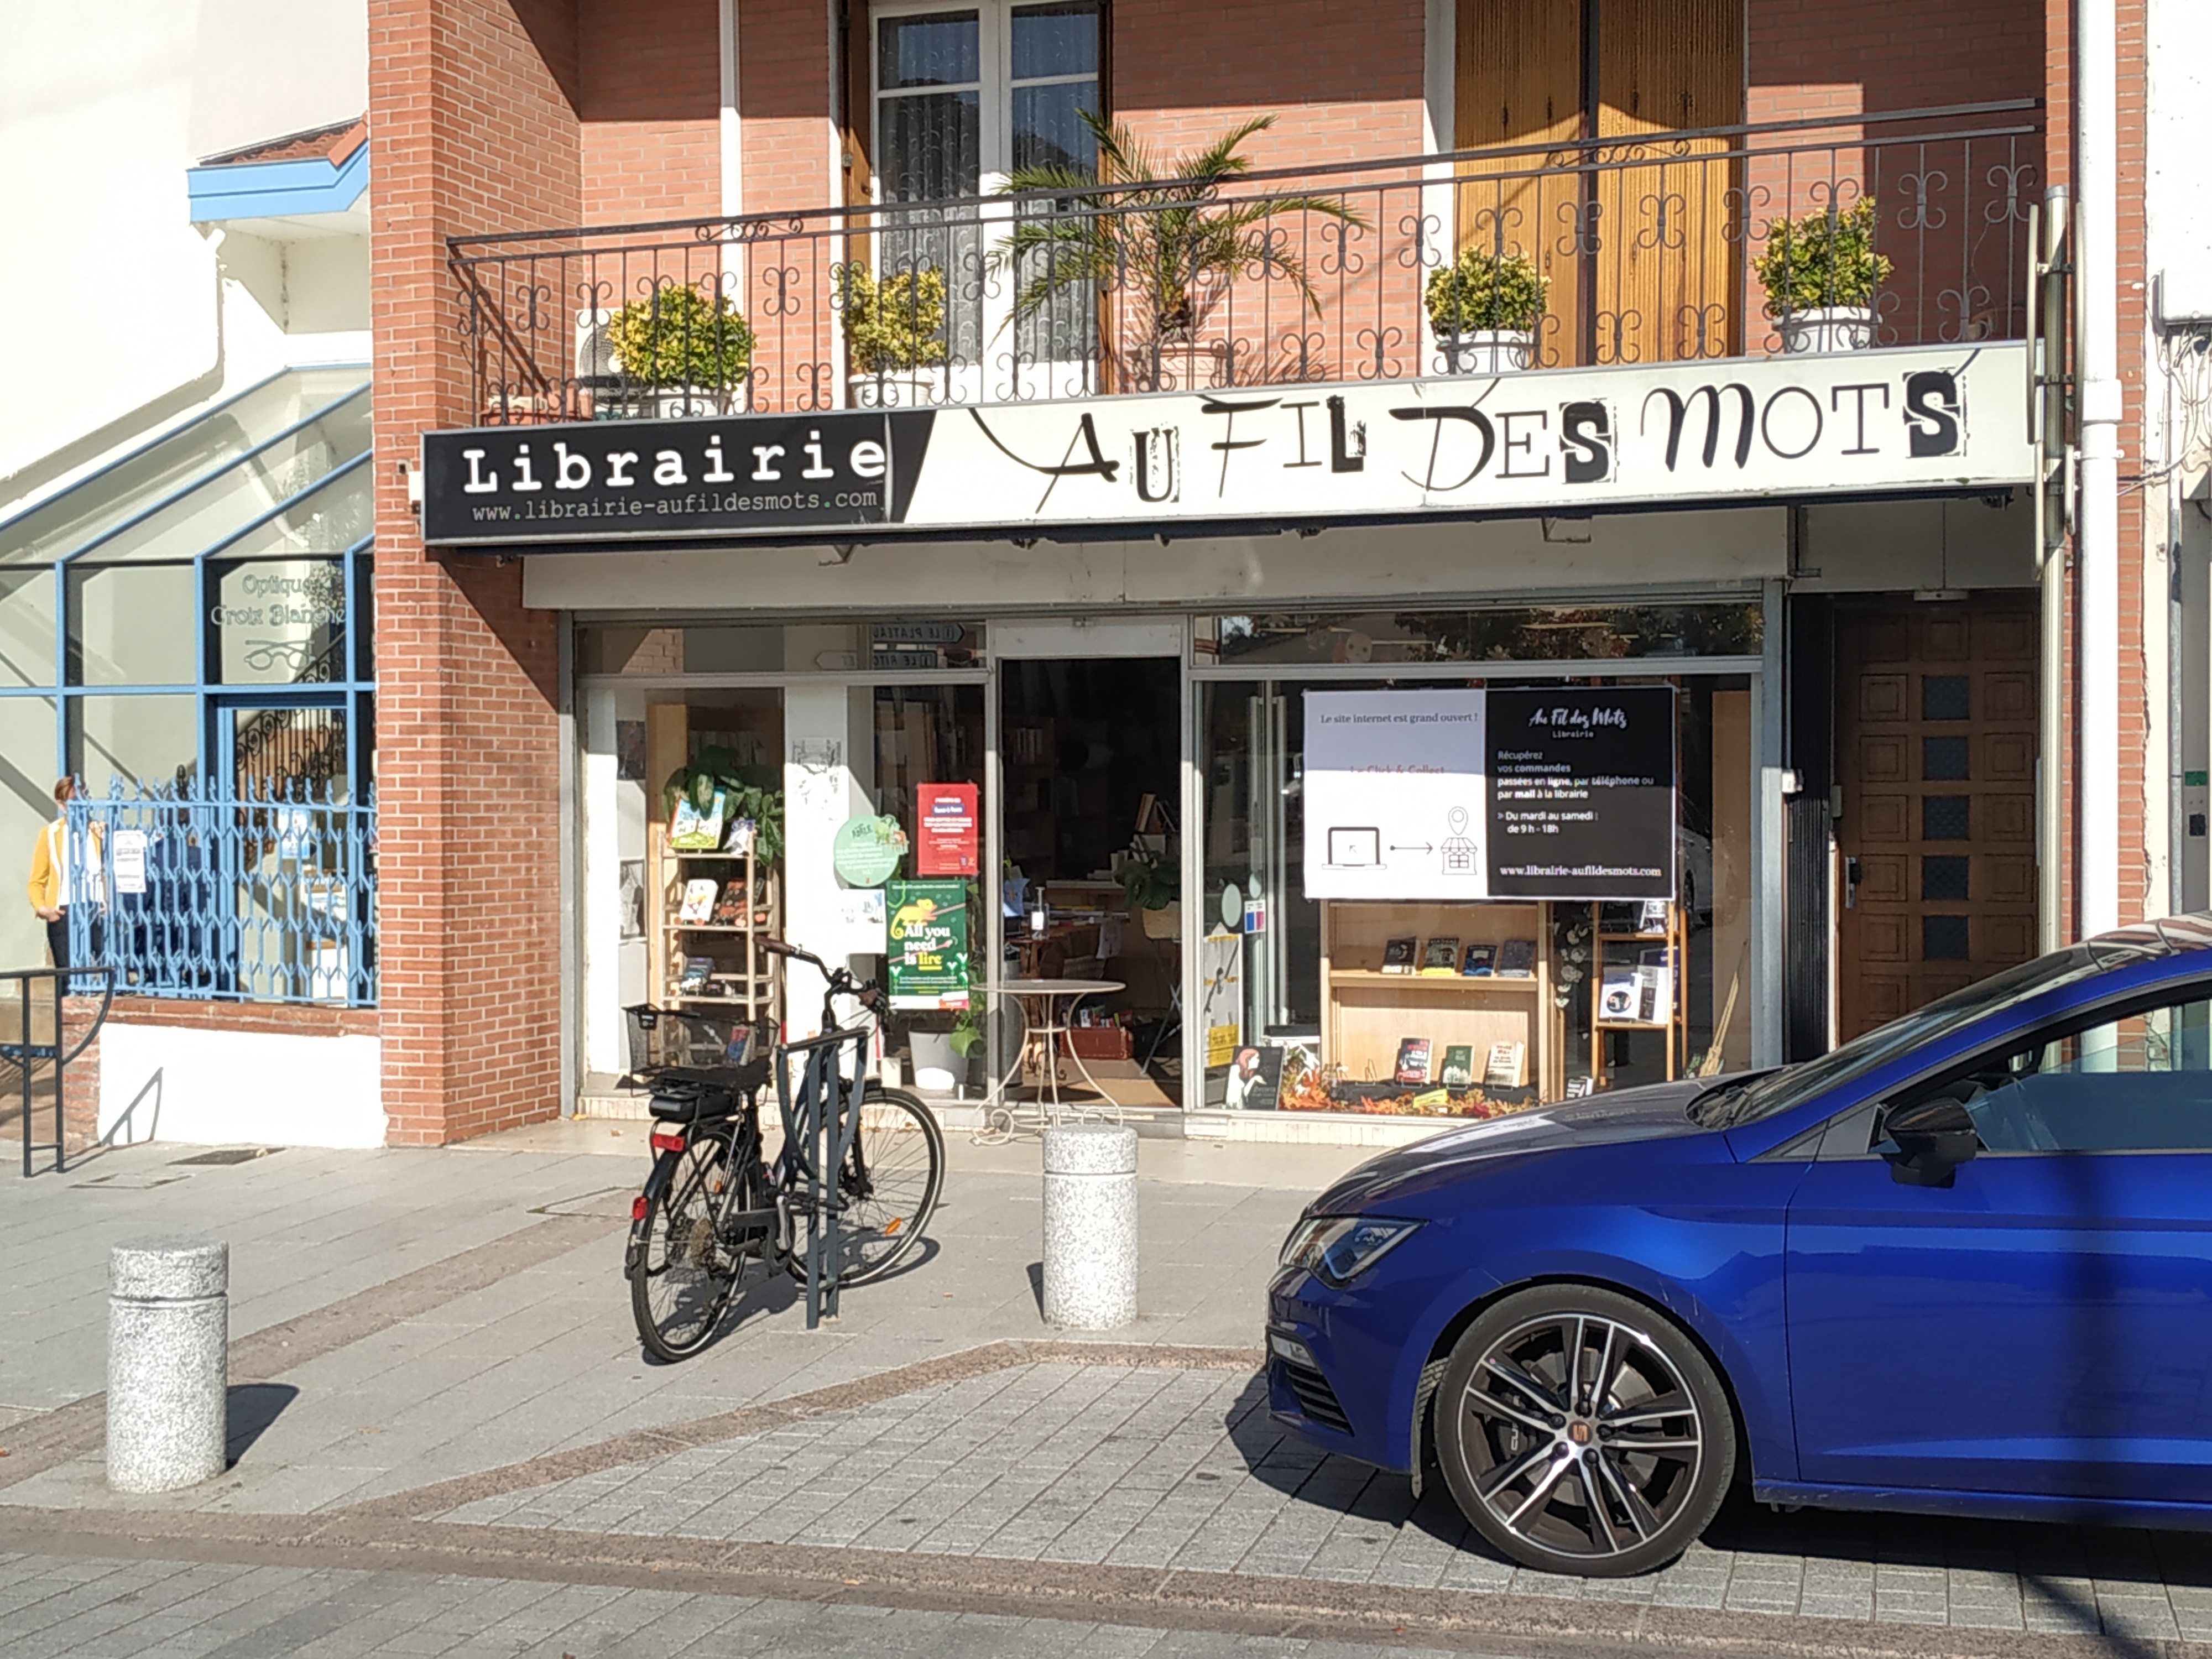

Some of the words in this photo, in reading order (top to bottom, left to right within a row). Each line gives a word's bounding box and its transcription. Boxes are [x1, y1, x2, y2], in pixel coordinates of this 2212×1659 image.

[984, 408, 1180, 514] AU
[1196, 394, 1366, 498] FIL
[1389, 397, 1614, 491] DES
[1641, 367, 1966, 472] MOTS
[462, 430, 885, 493] Librairie
[472, 491, 877, 521] www.librairie-aufildesmots.com
[211, 605, 263, 625] Croix
[1321, 714, 1332, 723] Le
[1334, 714, 1351, 723] site
[1353, 714, 1392, 723] internet
[1393, 714, 1408, 723] est
[1410, 713, 1438, 724] grand
[1440, 714, 1472, 722] ouvert
[1552, 730, 1594, 738] Librairie
[1498, 750, 1543, 761] Récupérez
[1514, 763, 1571, 773] commandes
[1498, 776, 1532, 787] passées
[1548, 776, 1573, 787] ligne,
[1574, 778, 1589, 787] par
[1592, 776, 1640, 787] téléphone
[1642, 777, 1654, 785] ou
[1498, 791, 1512, 800] par
[1514, 789, 1536, 799] mail
[1545, 789, 1553, 799] la
[1554, 789, 1588, 799] librairie
[1505, 812, 1519, 821] Du
[1520, 811, 1546, 820] mardi
[1561, 811, 1593, 820] samedi
[1507, 825, 1519, 833] de
[1542, 824, 1559, 833] 18h
[1500, 865, 1662, 877] www.librairie-aufildesmots.com
[905, 925, 923, 937] All
[925, 927, 950, 941] you
[904, 937, 936, 951] need
[919, 952, 943, 965] lire
